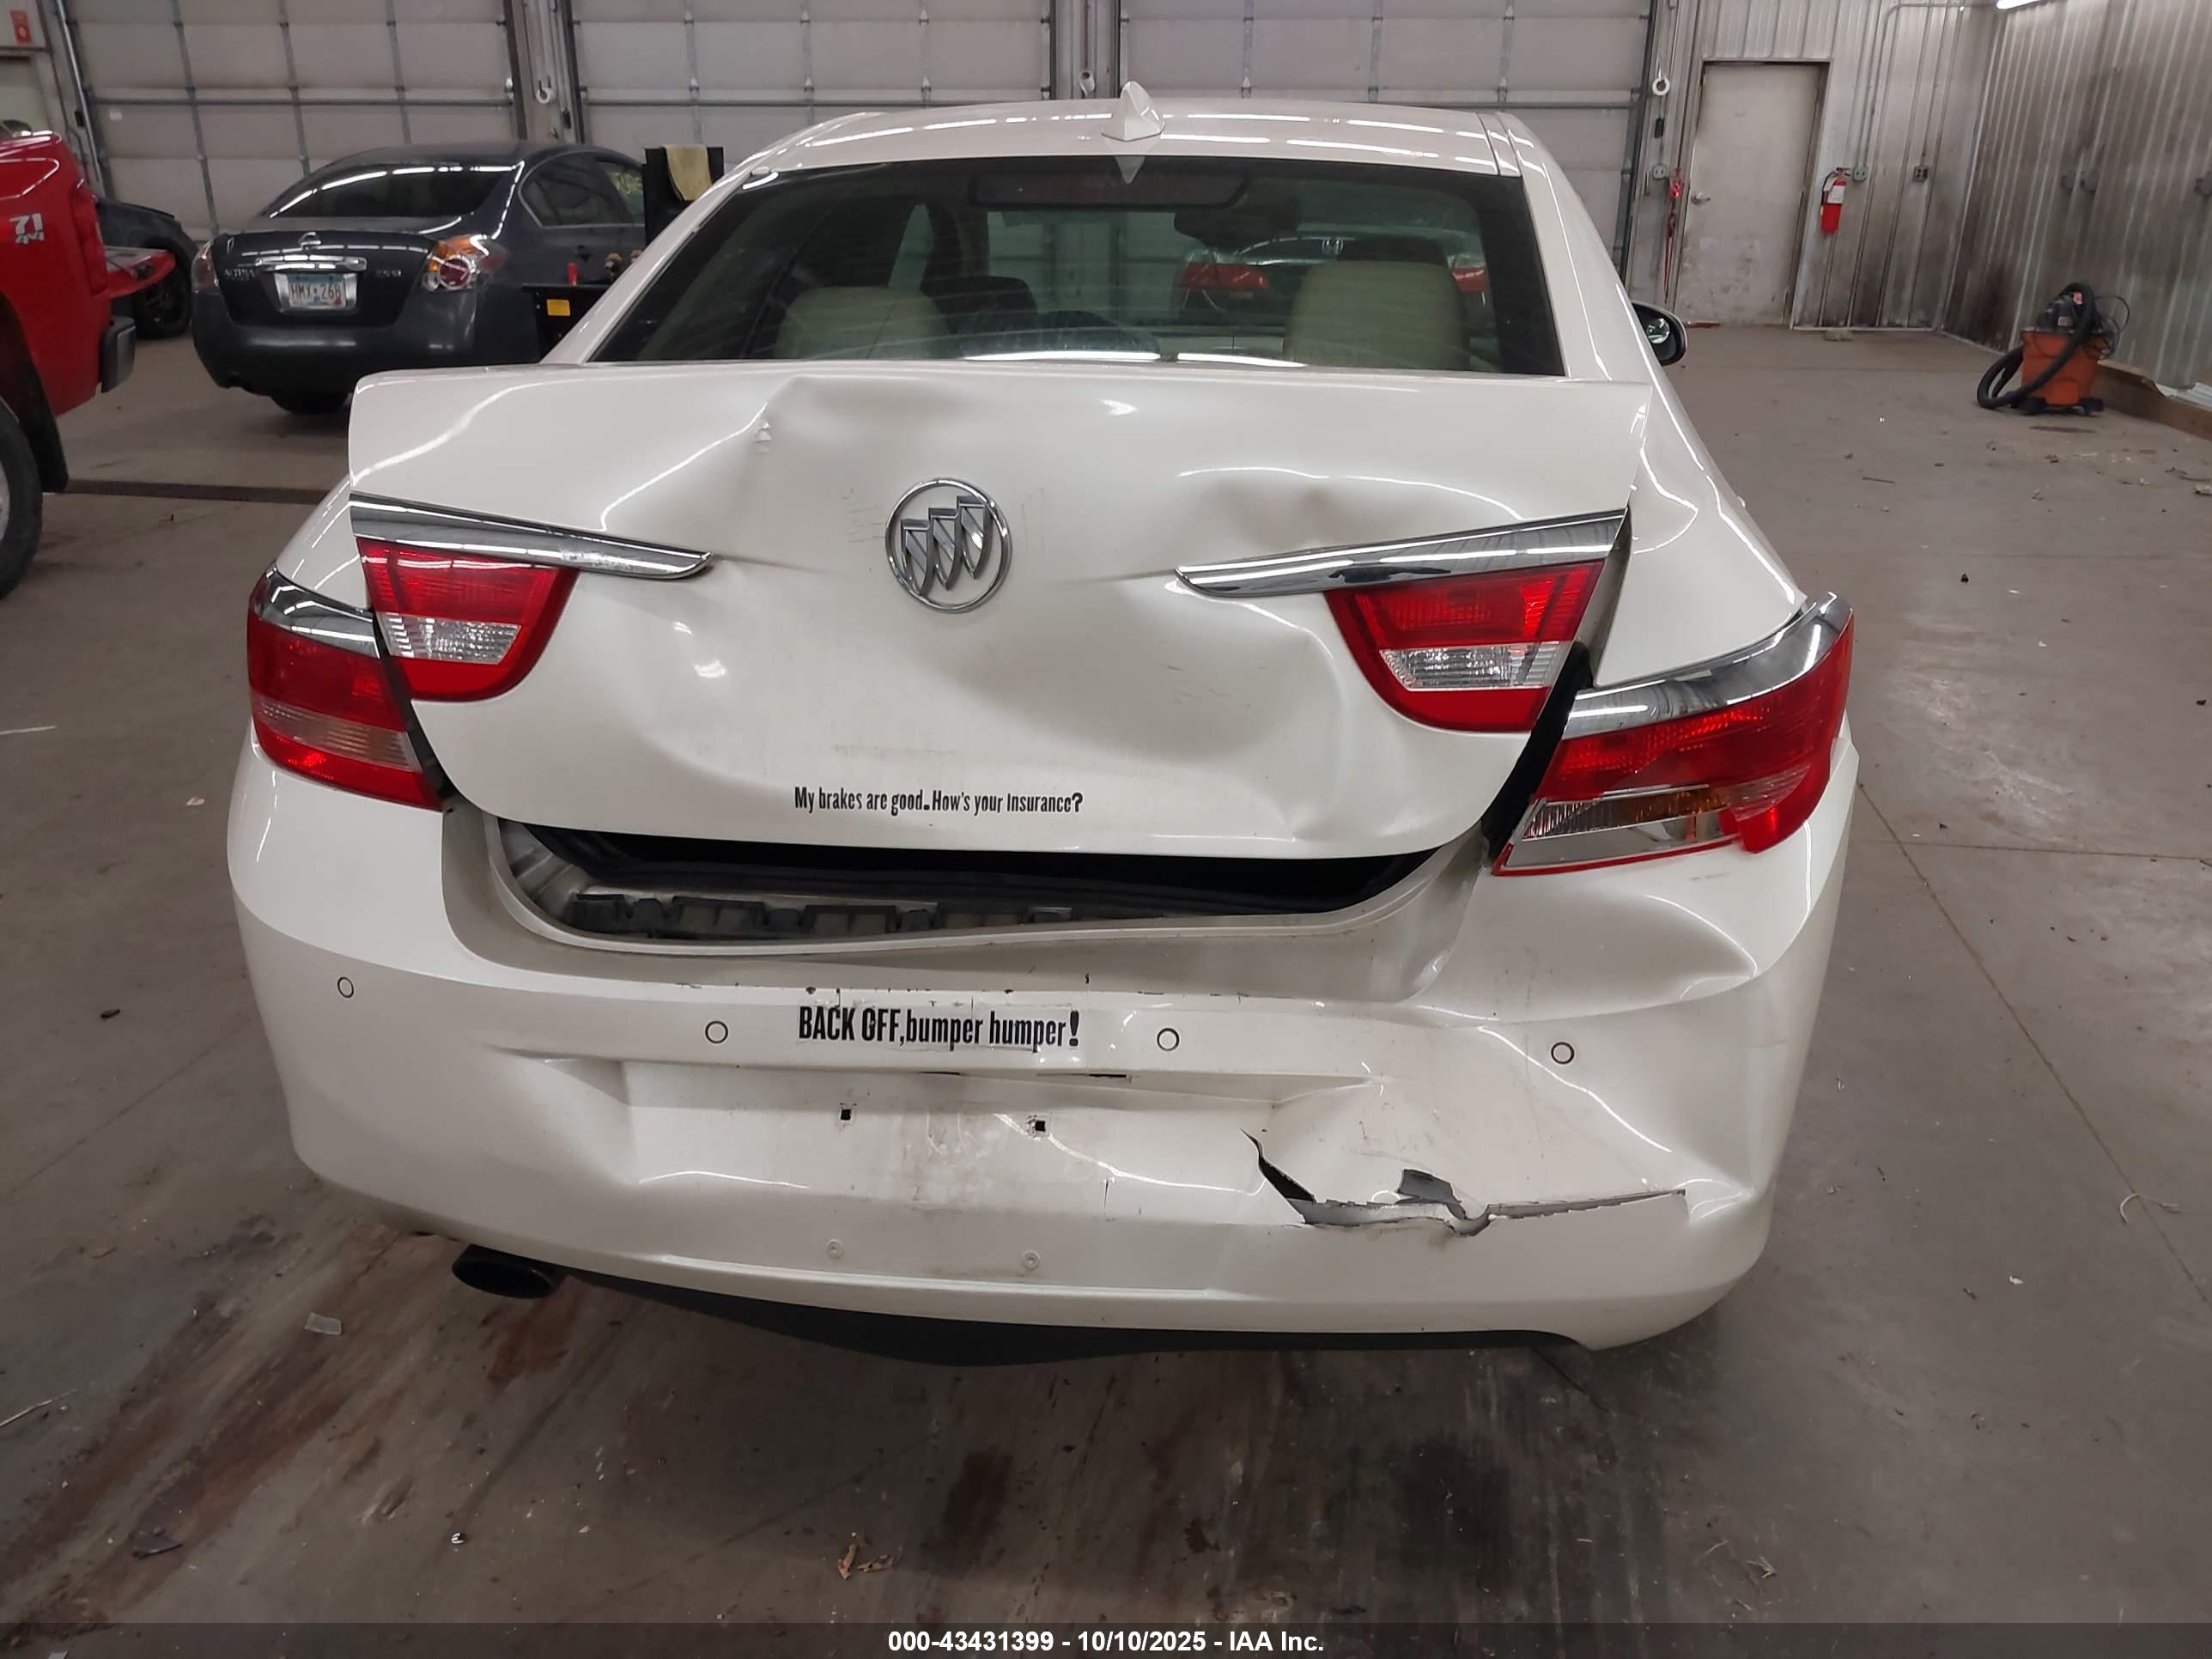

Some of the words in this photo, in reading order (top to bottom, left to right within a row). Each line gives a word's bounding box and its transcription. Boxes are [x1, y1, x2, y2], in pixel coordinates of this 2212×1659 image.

[794, 787, 815, 815] My
[818, 787, 861, 810] brakes
[866, 793, 888, 811] are
[974, 795, 1004, 817] your
[799, 1007, 856, 1041] BACK
